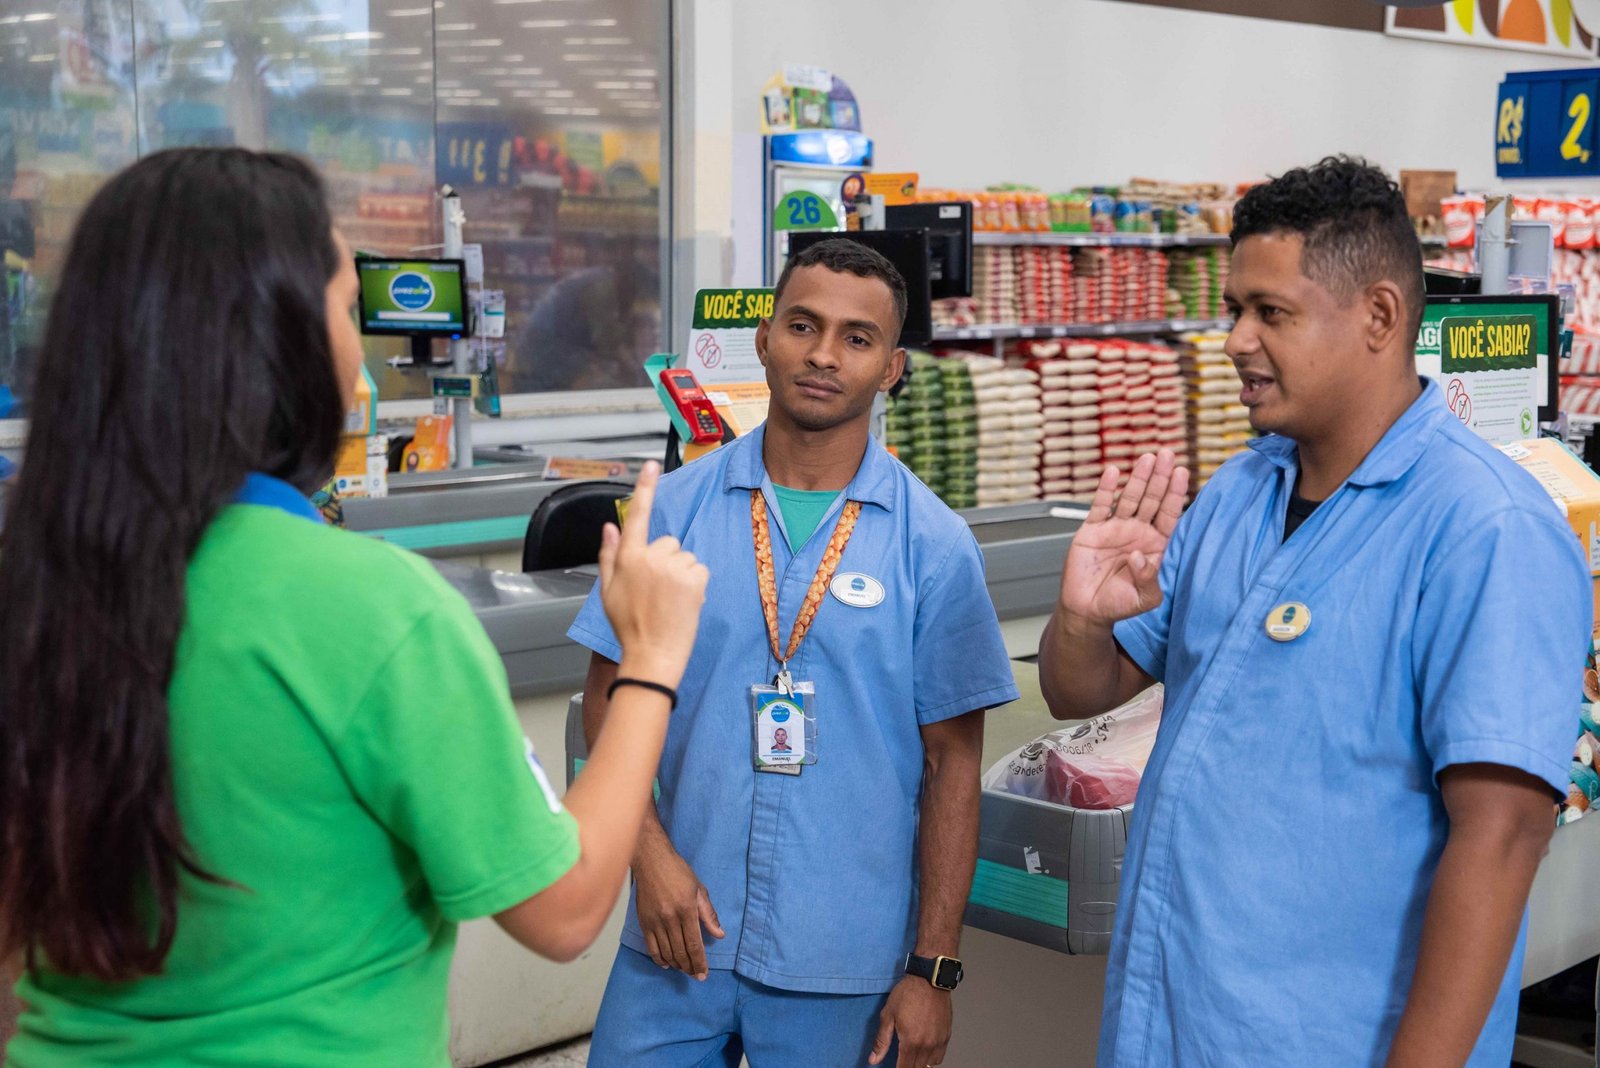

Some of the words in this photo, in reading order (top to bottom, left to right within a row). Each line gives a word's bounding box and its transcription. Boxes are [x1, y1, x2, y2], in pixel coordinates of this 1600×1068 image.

[1497, 96, 1524, 145] R$
[787, 195, 821, 225] 26
[704, 290, 743, 320] VOCÊ
[1449, 319, 1484, 359] VOCÊ
[1487, 323, 1531, 357] SABIA?
